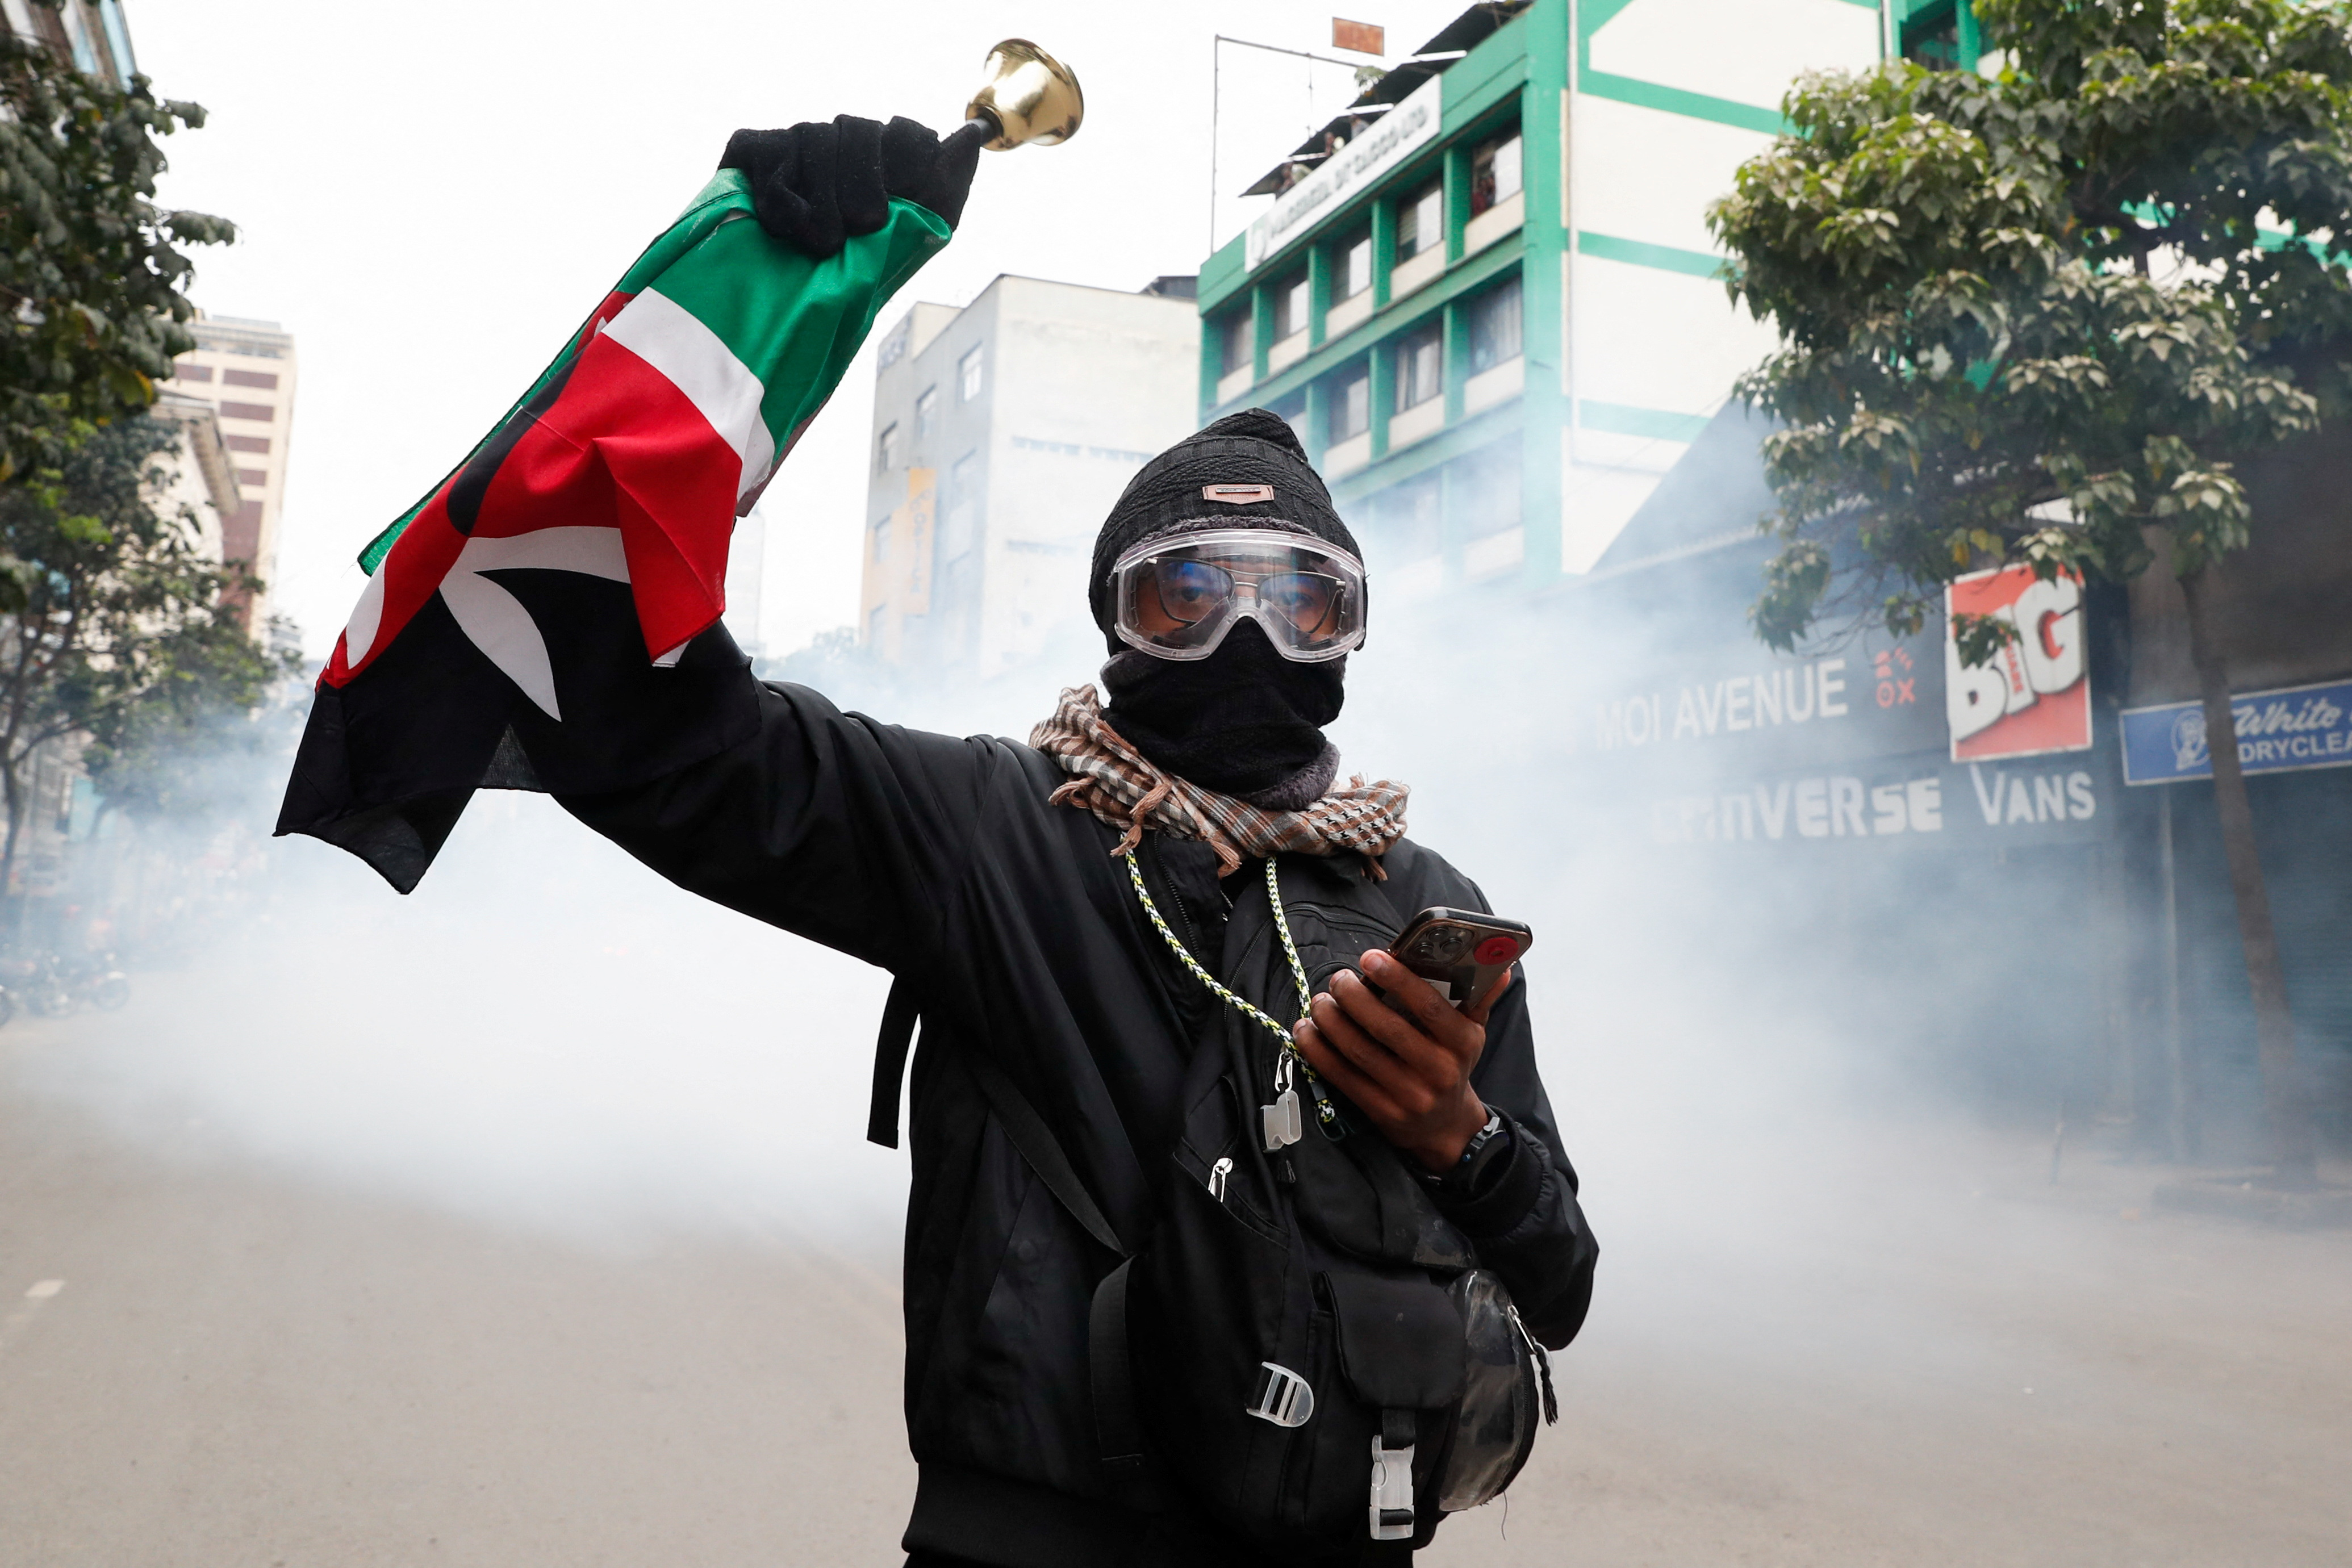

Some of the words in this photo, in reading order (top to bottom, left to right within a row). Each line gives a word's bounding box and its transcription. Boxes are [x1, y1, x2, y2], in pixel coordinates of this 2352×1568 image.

[1595, 693, 1661, 751] MOI
[1672, 659, 1848, 740] AVENUE
[2232, 697, 2342, 737] White
[1969, 763, 2096, 825] VANS
